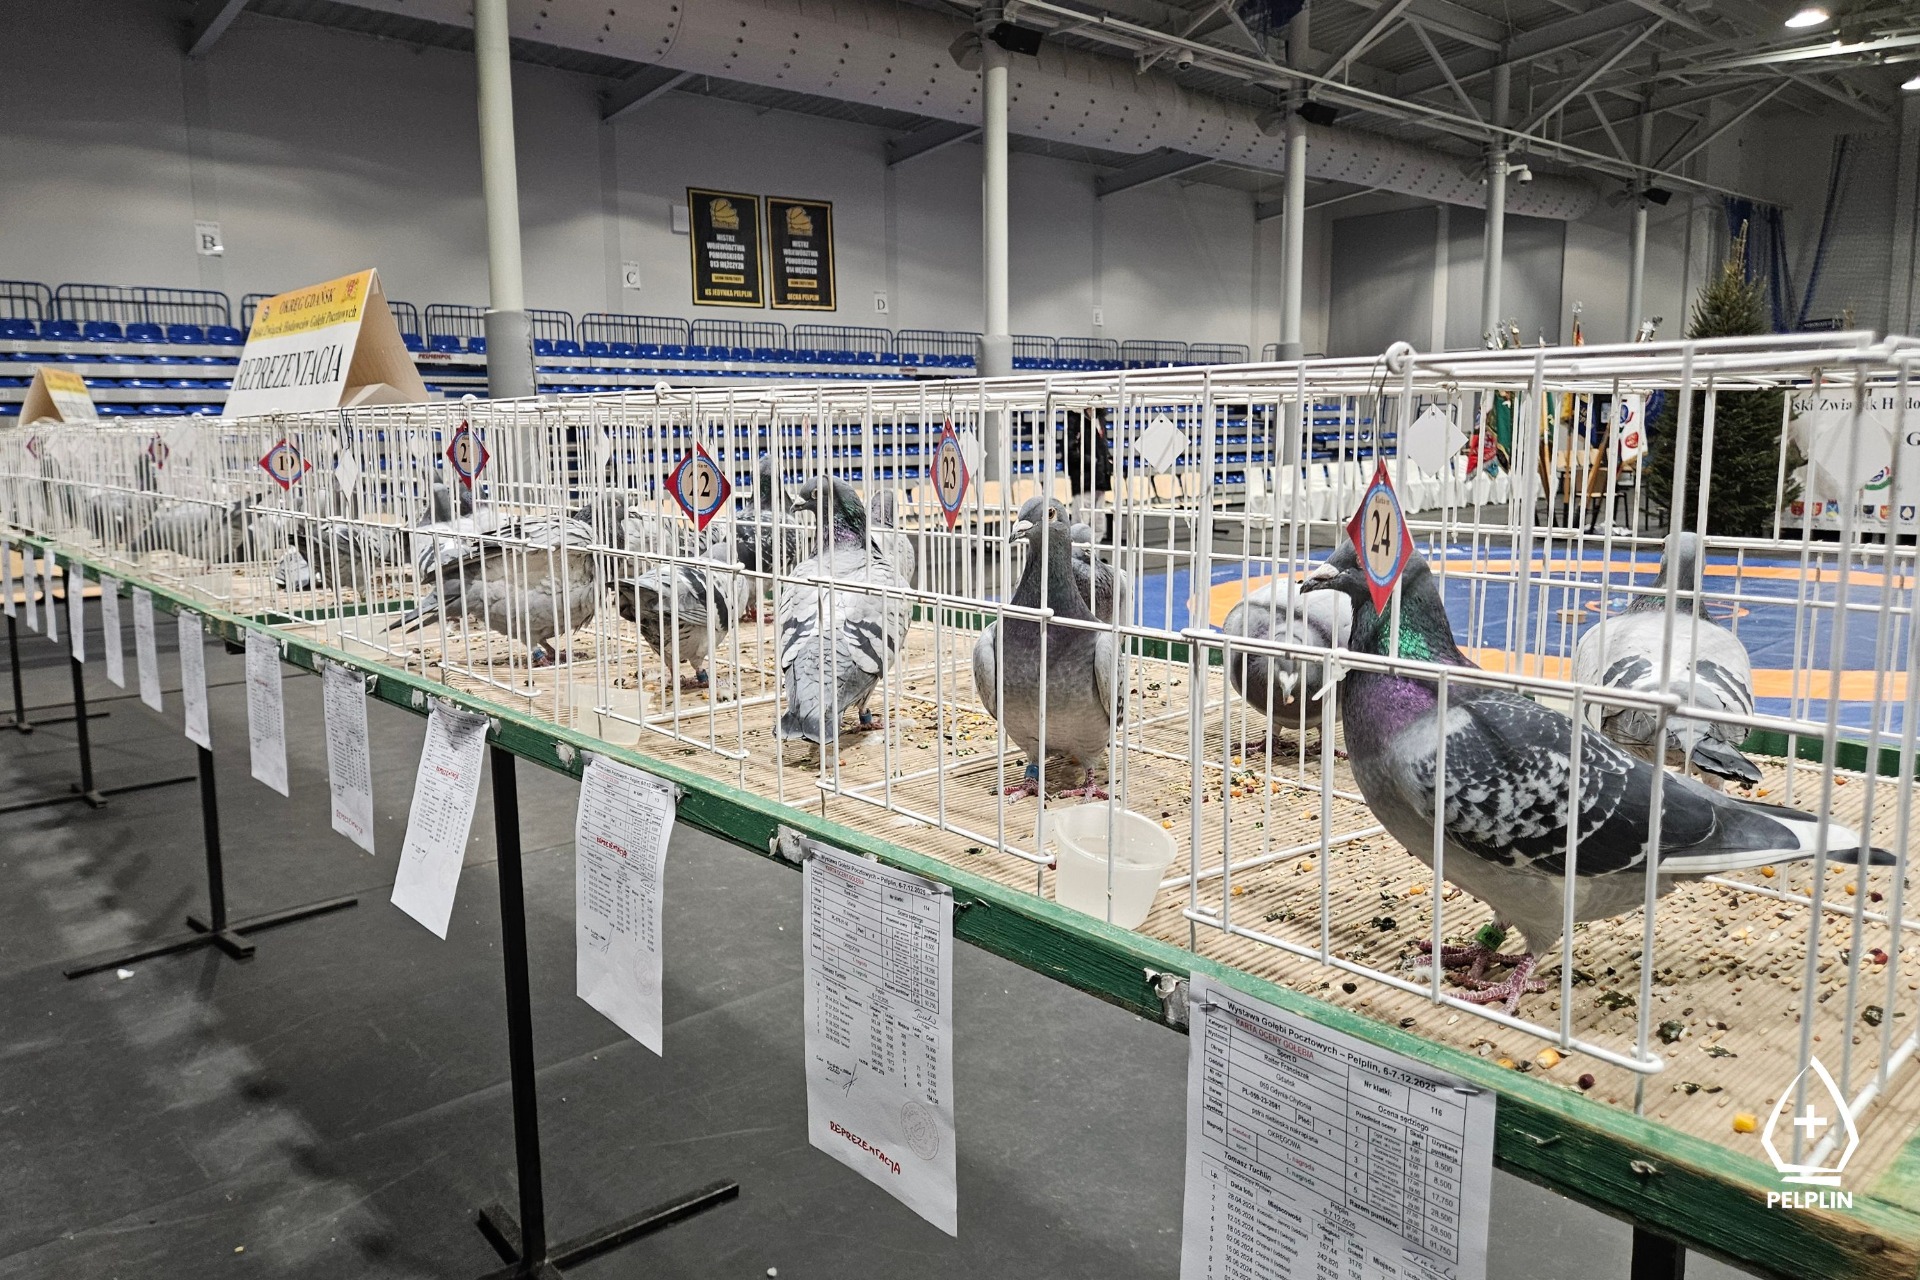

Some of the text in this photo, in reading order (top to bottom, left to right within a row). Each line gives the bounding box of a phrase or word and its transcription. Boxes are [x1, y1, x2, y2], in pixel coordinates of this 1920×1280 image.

[202, 234, 216, 248] B
[627, 271, 636, 284] C
[304, 286, 336, 308] GDAŃSK
[878, 299, 885, 310] D
[325, 305, 357, 323] Pocztowych
[234, 344, 343, 391] REPREZENTACJA
[1794, 399, 1813, 411] ski
[943, 456, 956, 489] 23
[1371, 509, 1390, 556] 24
[851, 865, 875, 880] Pocztowych
[1227, 1001, 1259, 1024] Wystawa
[1261, 1016, 1286, 1035] Gołębi
[1288, 1028, 1337, 1056] Pocztowych
[1347, 1052, 1380, 1074] Pelplin,
[1383, 1064, 1436, 1095] 6-7.12.2025
[1235, 1017, 1313, 1061] KARTA OCENY GOŁĘBIA
[1276, 1048, 1291, 1062] Sport
[1372, 1082, 1392, 1098] klatki:
[1377, 1104, 1428, 1134] Ocena sędziego
[1430, 1106, 1442, 1117] 116
[830, 1121, 901, 1175] REPREZENTACJA
[1224, 1150, 1271, 1182] Tomasz Tuchlin
[1292, 1156, 1314, 1173] nagroda
[1210, 1169, 1218, 1180] Lp.
[1230, 1180, 1242, 1192] Data
[1243, 1187, 1253, 1198] lotu
[1291, 1170, 1314, 1188] nagroda
[1349, 1198, 1369, 1214] Razem
[1372, 1256, 1395, 1275] Miejsce
